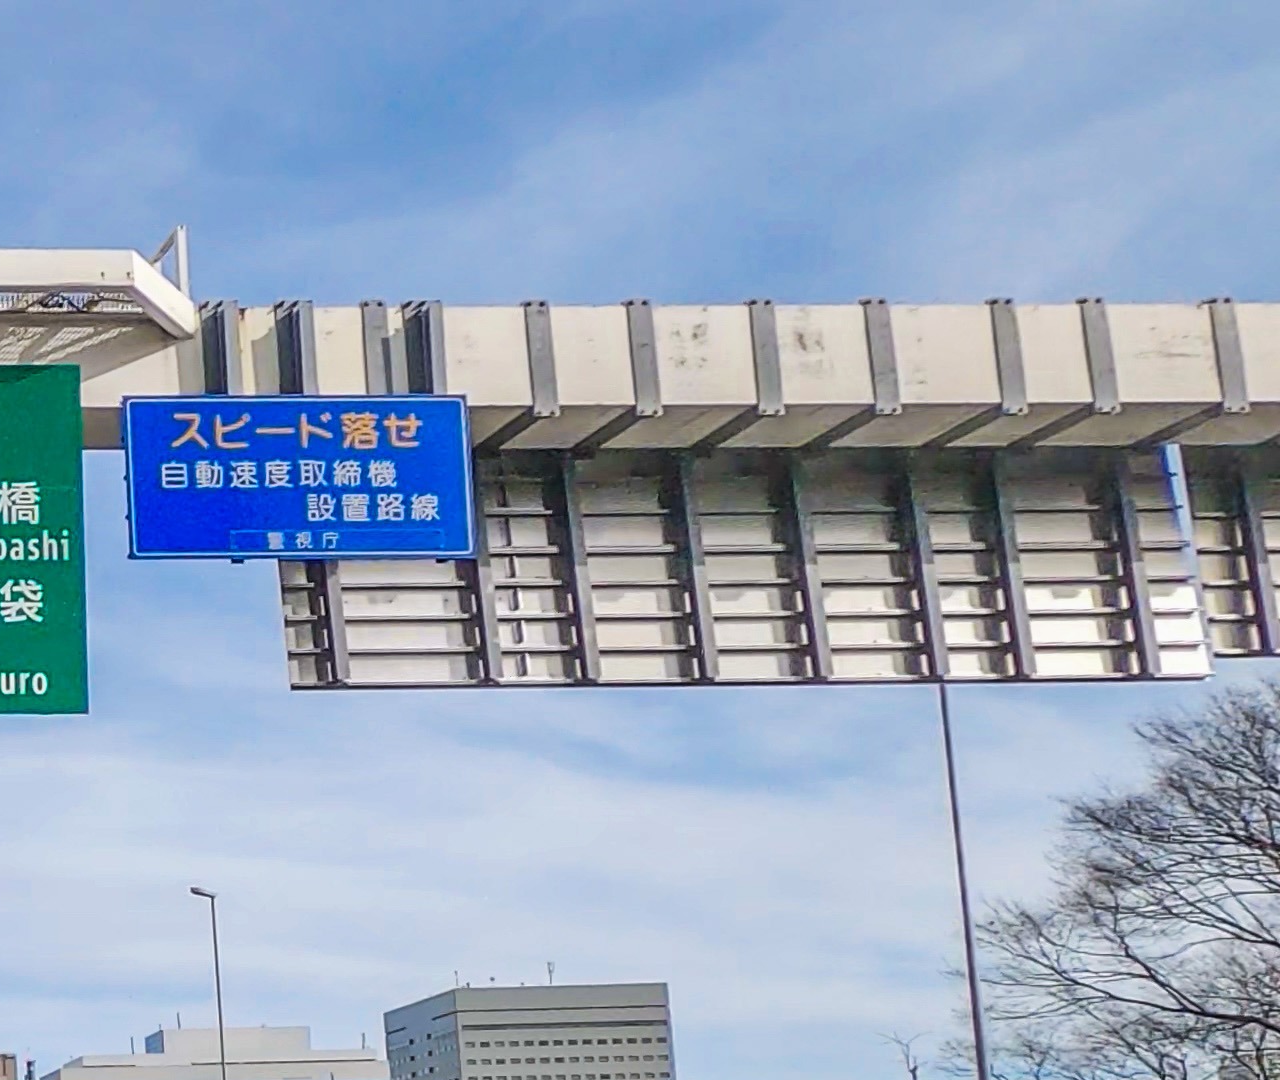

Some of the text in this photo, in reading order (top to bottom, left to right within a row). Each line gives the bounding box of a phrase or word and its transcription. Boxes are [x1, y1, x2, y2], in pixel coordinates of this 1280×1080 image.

[171, 411, 423, 449] スピード落せ
[161, 460, 397, 488] 自動速度取締機
[307, 493, 440, 521] 設置路線
